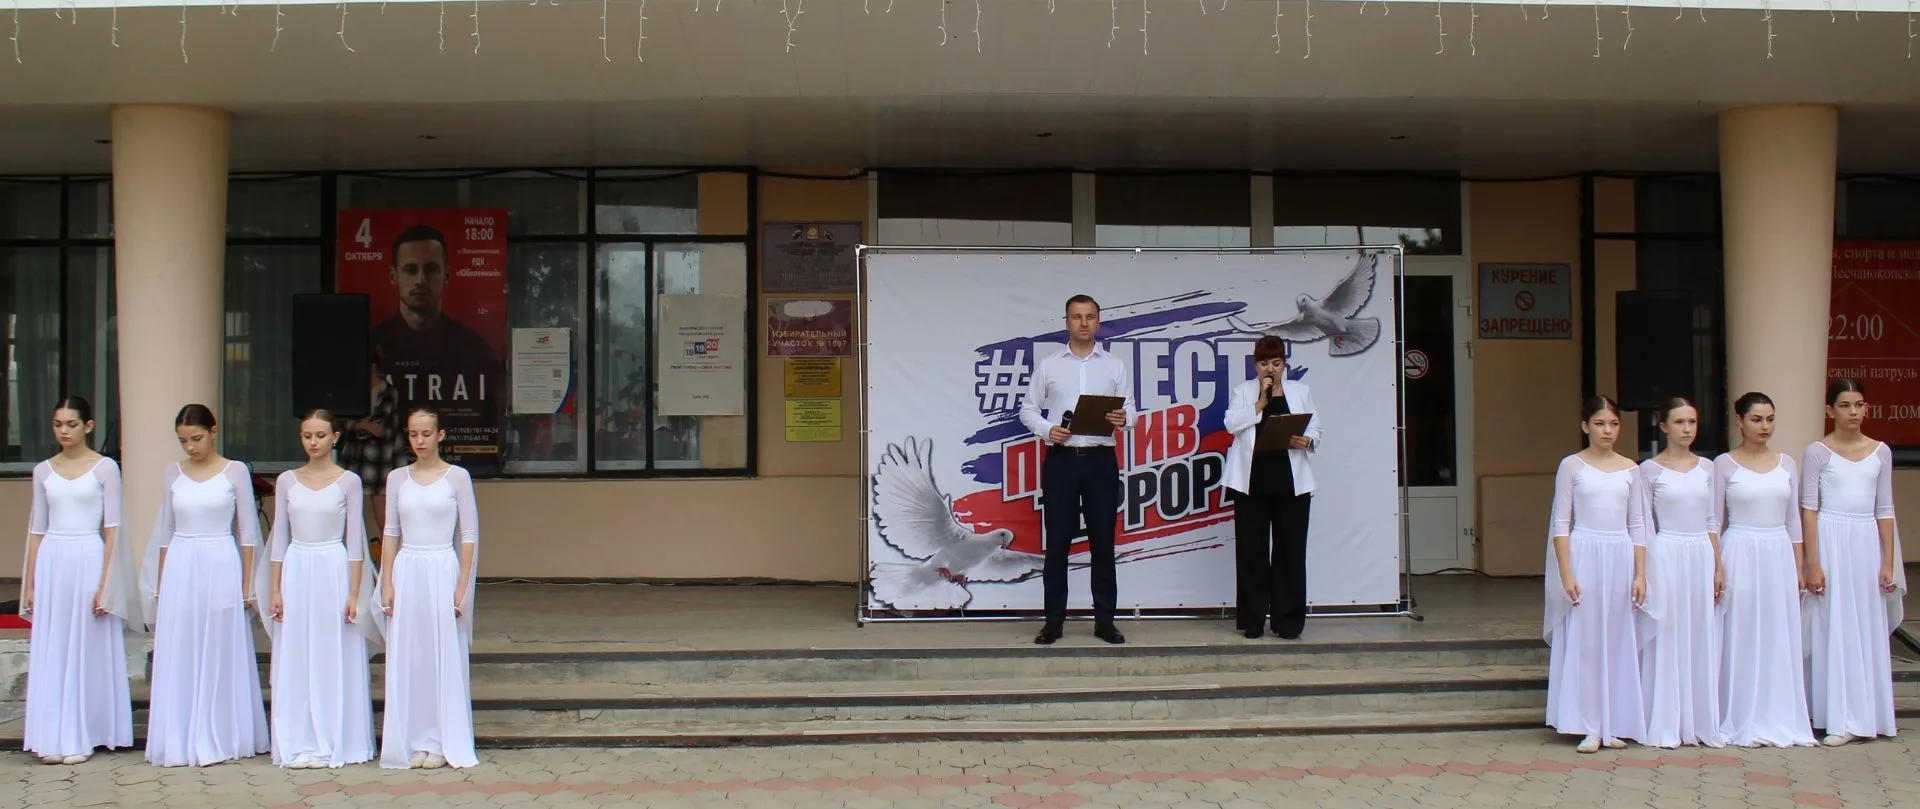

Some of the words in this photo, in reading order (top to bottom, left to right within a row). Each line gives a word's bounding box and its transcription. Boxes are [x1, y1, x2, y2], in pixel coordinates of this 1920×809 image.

[464, 217, 495, 226] НАЧАЛО
[354, 218, 373, 249] 4
[465, 228, 494, 241] 18:00
[345, 252, 383, 261] ОКТЯБРЯ
[1844, 248, 1885, 263] спорта
[1491, 269, 1557, 284] КУРЕНИЕ
[1833, 265, 1920, 280] есчанокопско
[772, 329, 847, 338] ИЗБИРАТЕЛЬНЫЙ
[1481, 318, 1570, 335] ЗАПРЕЩЕНО
[1827, 365, 1867, 378] ежный
[1870, 367, 1918, 382] патруль
